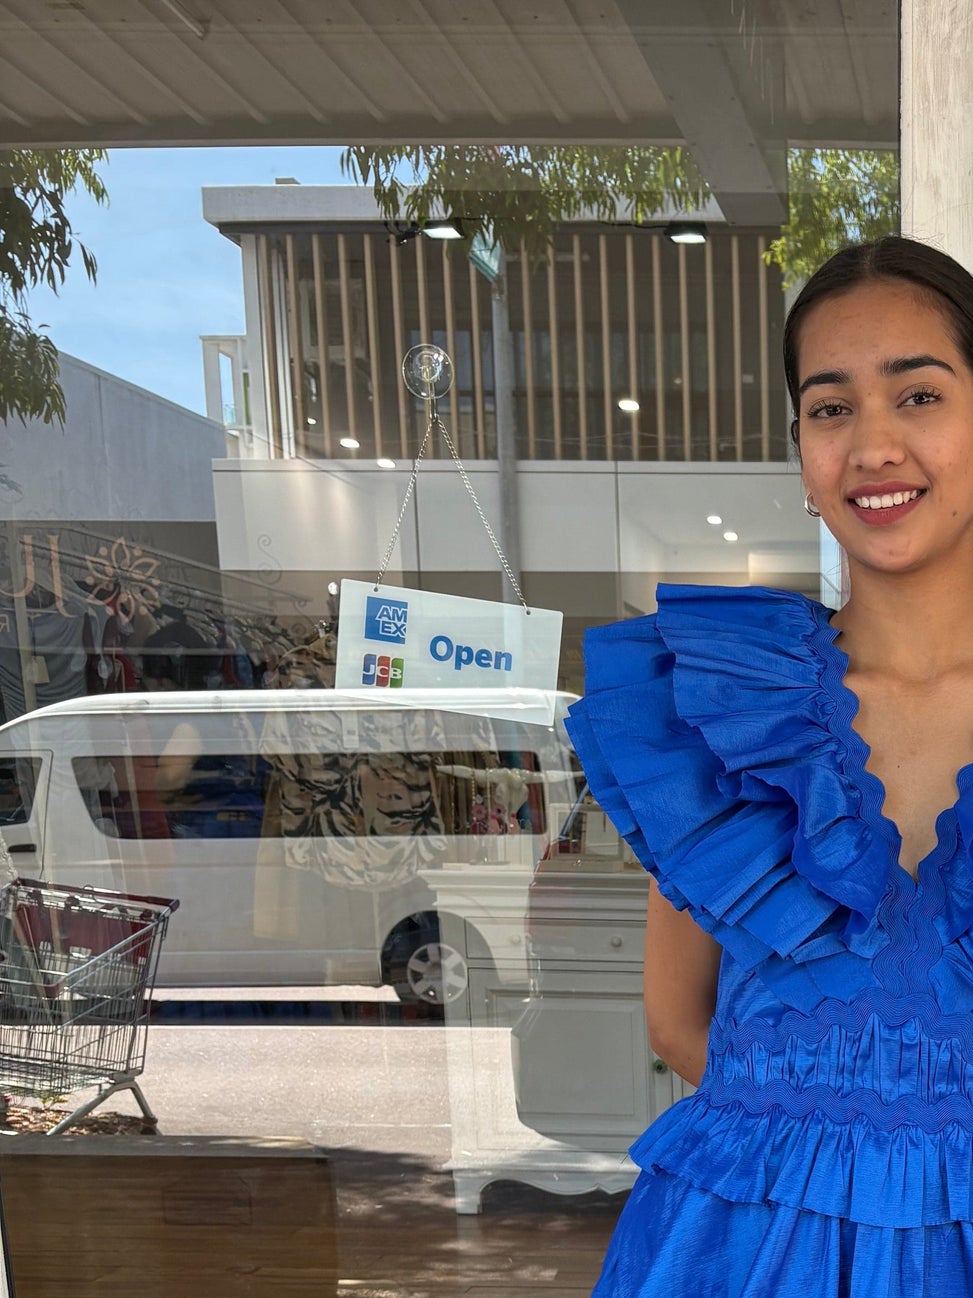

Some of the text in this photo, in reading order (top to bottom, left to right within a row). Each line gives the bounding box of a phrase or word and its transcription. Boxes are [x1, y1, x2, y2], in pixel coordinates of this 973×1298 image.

[376, 605, 408, 622] AM
[380, 620, 406, 638] EX
[429, 635, 512, 671] Open
[362, 662, 404, 682] JCB
